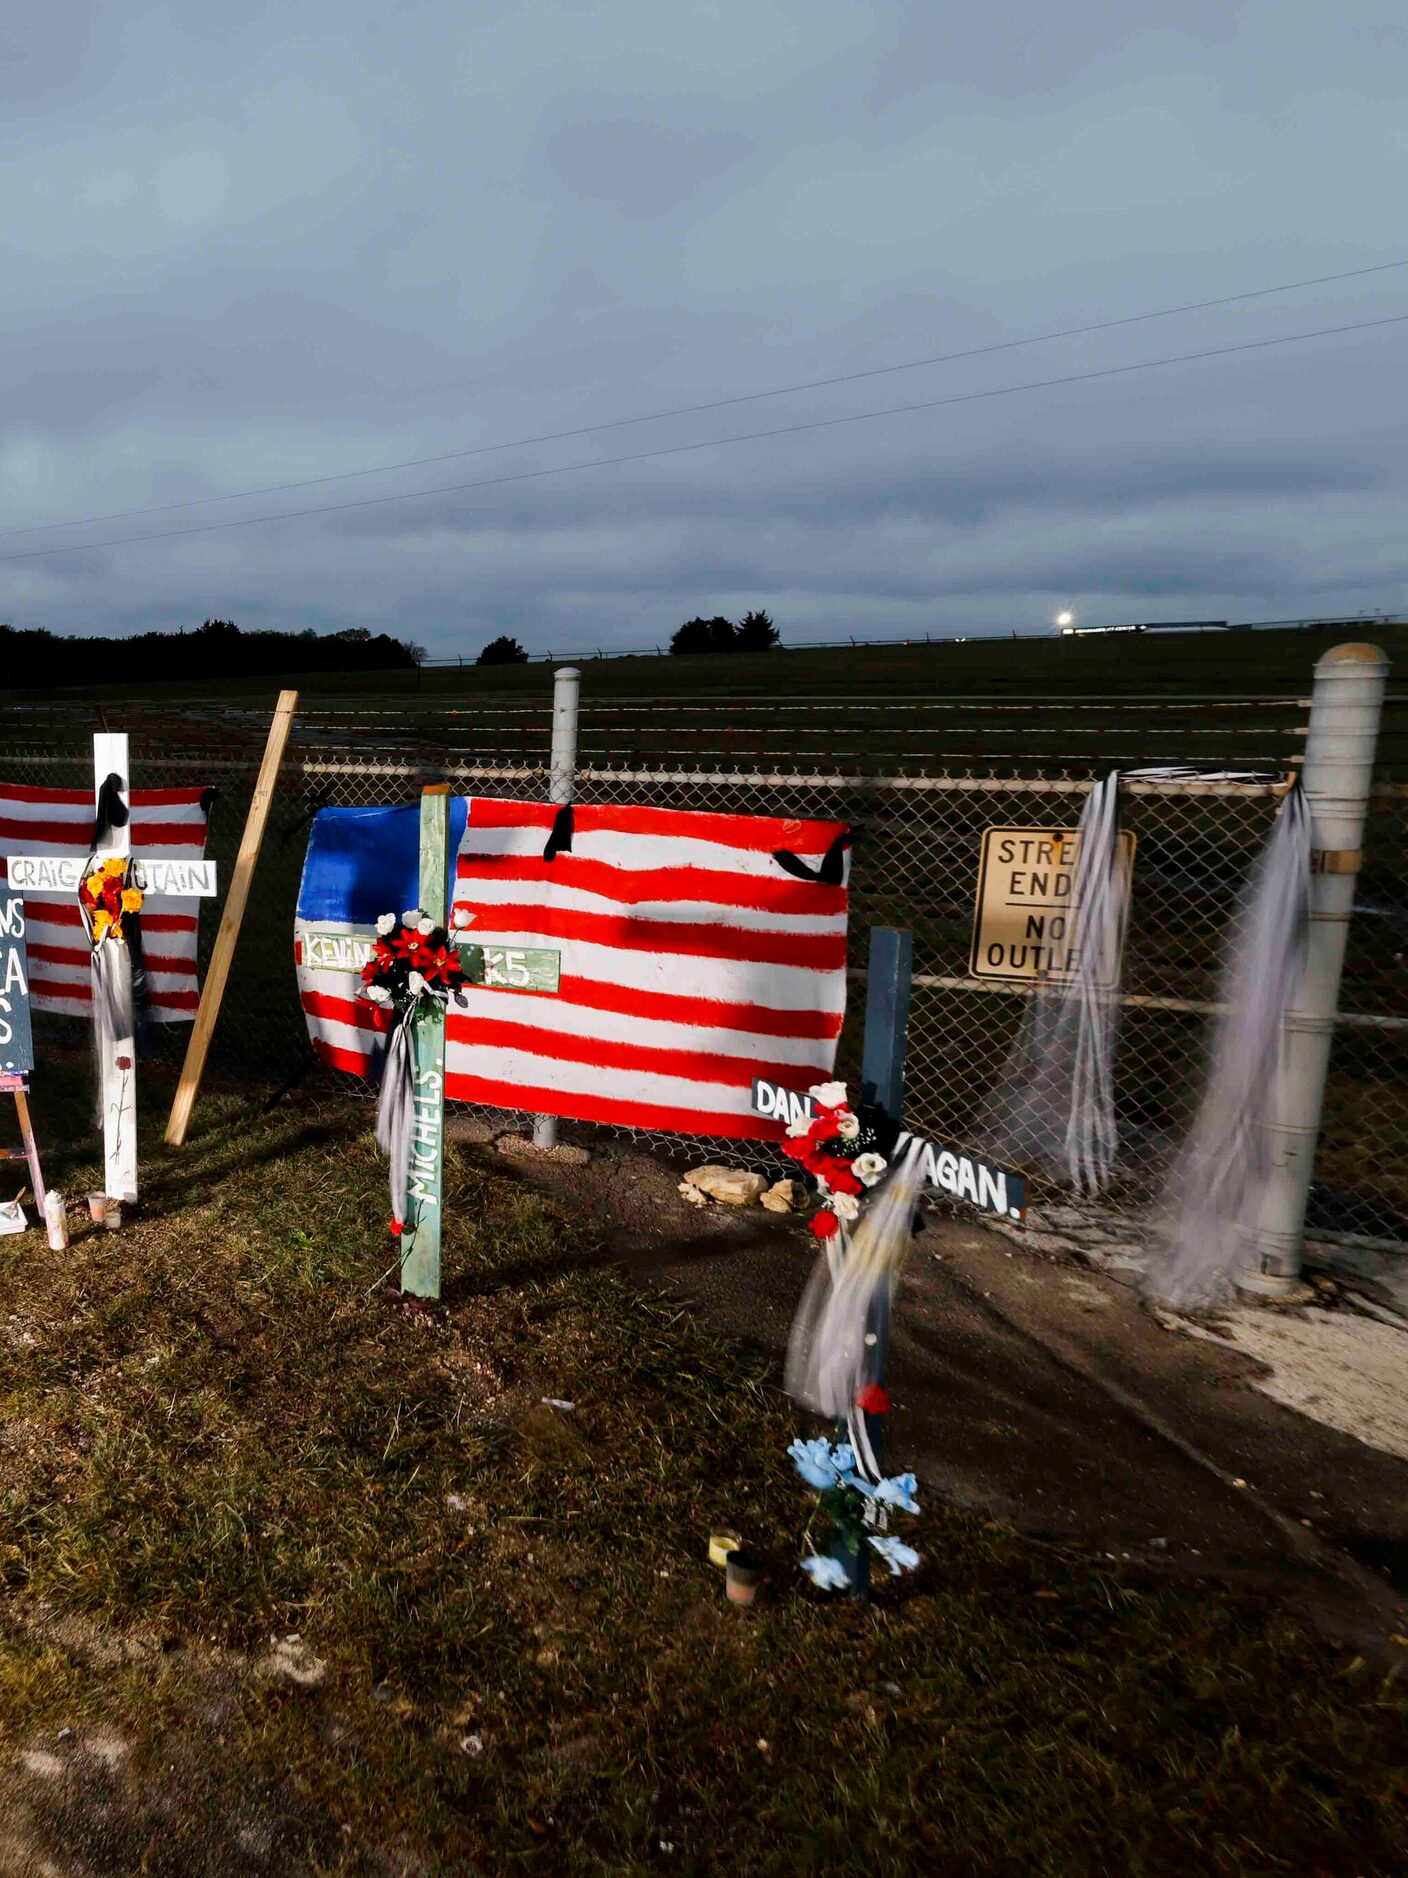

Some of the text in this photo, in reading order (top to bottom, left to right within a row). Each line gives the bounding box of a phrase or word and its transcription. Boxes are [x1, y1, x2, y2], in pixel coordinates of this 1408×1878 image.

[997, 839, 1075, 866] STRE
[1025, 915, 1066, 941] NO
[986, 942, 1082, 973] OUTLE
[757, 1080, 811, 1125] DAN
